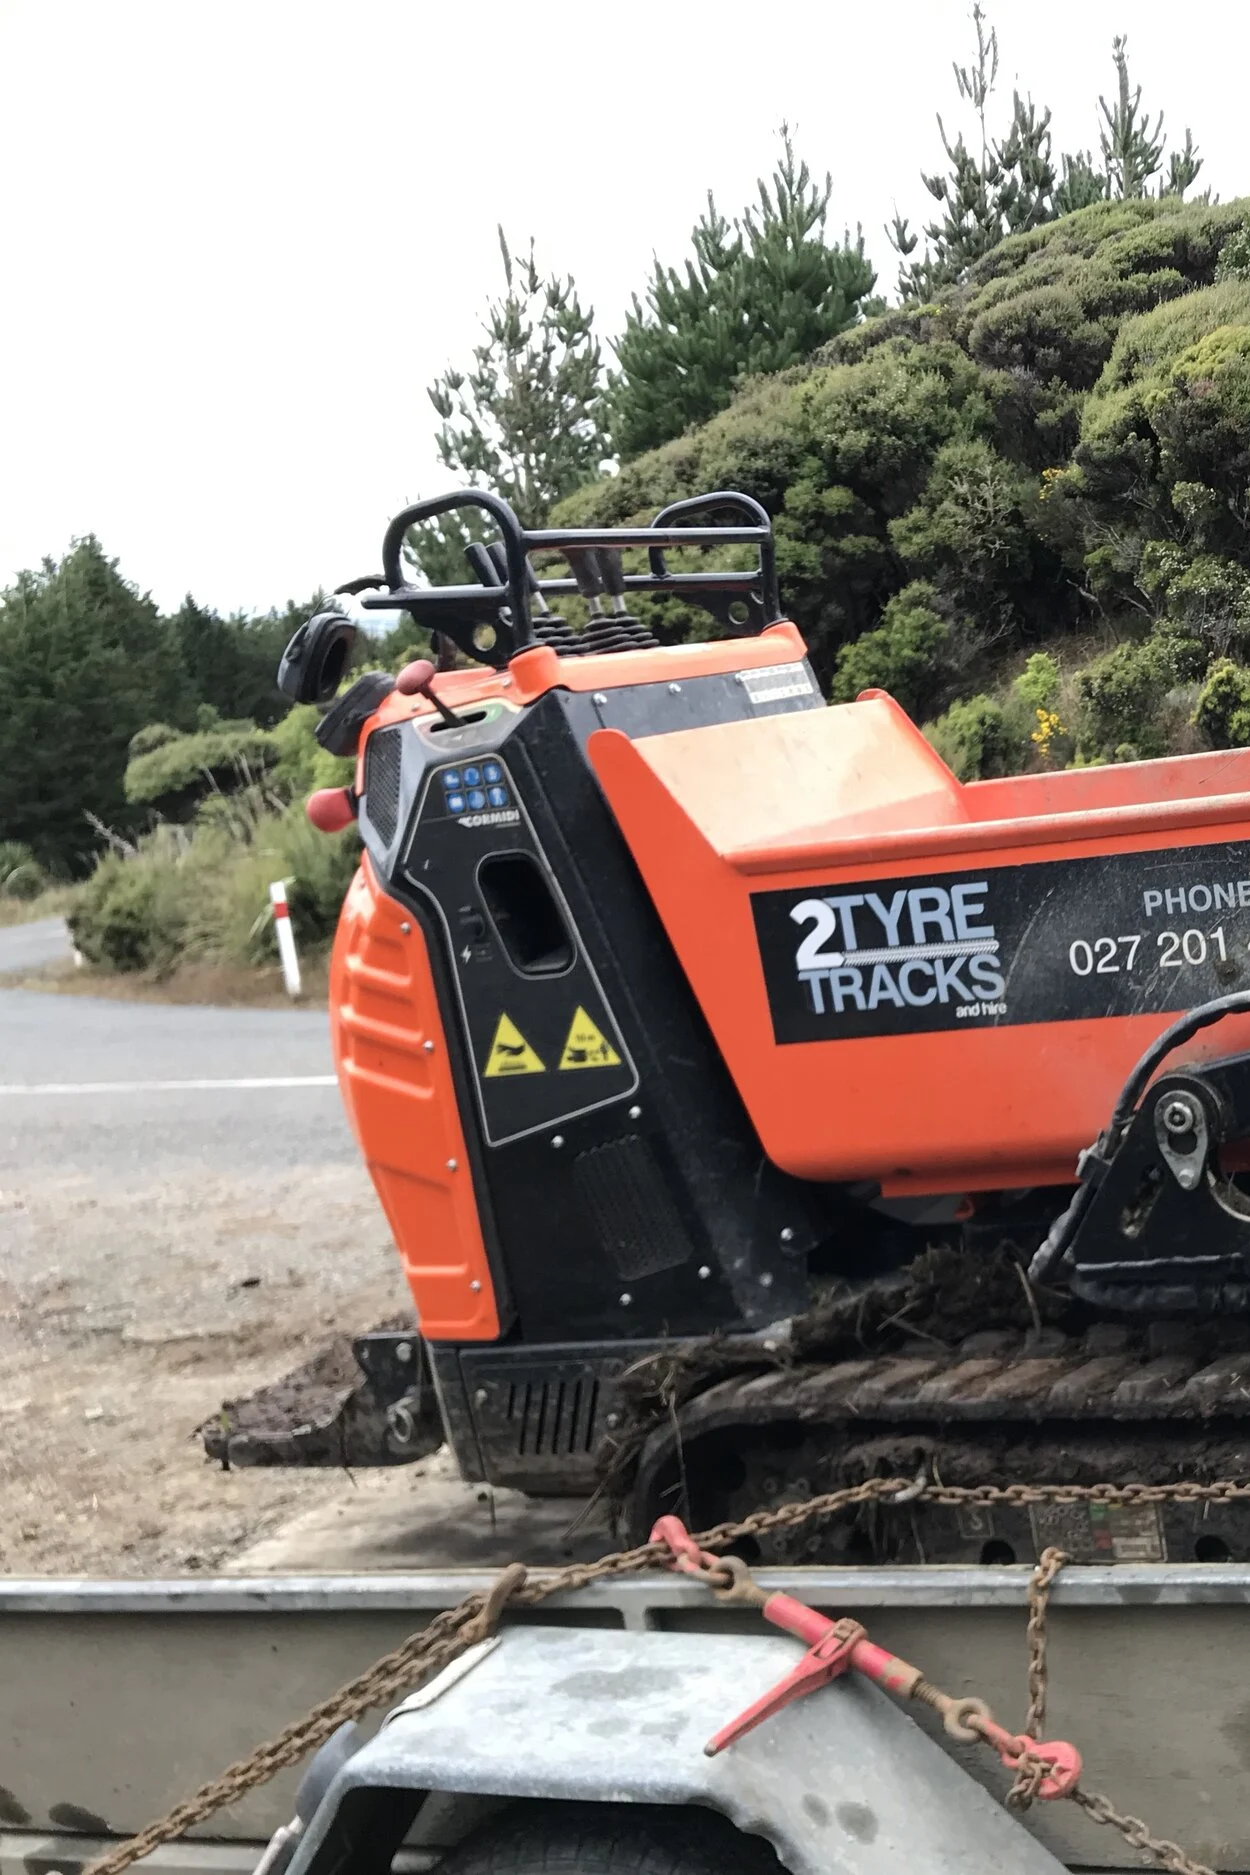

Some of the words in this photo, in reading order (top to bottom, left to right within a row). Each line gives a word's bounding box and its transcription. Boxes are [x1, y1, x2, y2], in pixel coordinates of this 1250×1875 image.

[459, 809, 520, 828] CORMIDI
[1069, 934, 1142, 976] 027
[1157, 926, 1228, 967] 201
[798, 954, 1006, 1015] TRACKS
[956, 1002, 980, 1018] and
[981, 1001, 1008, 1015] hire
